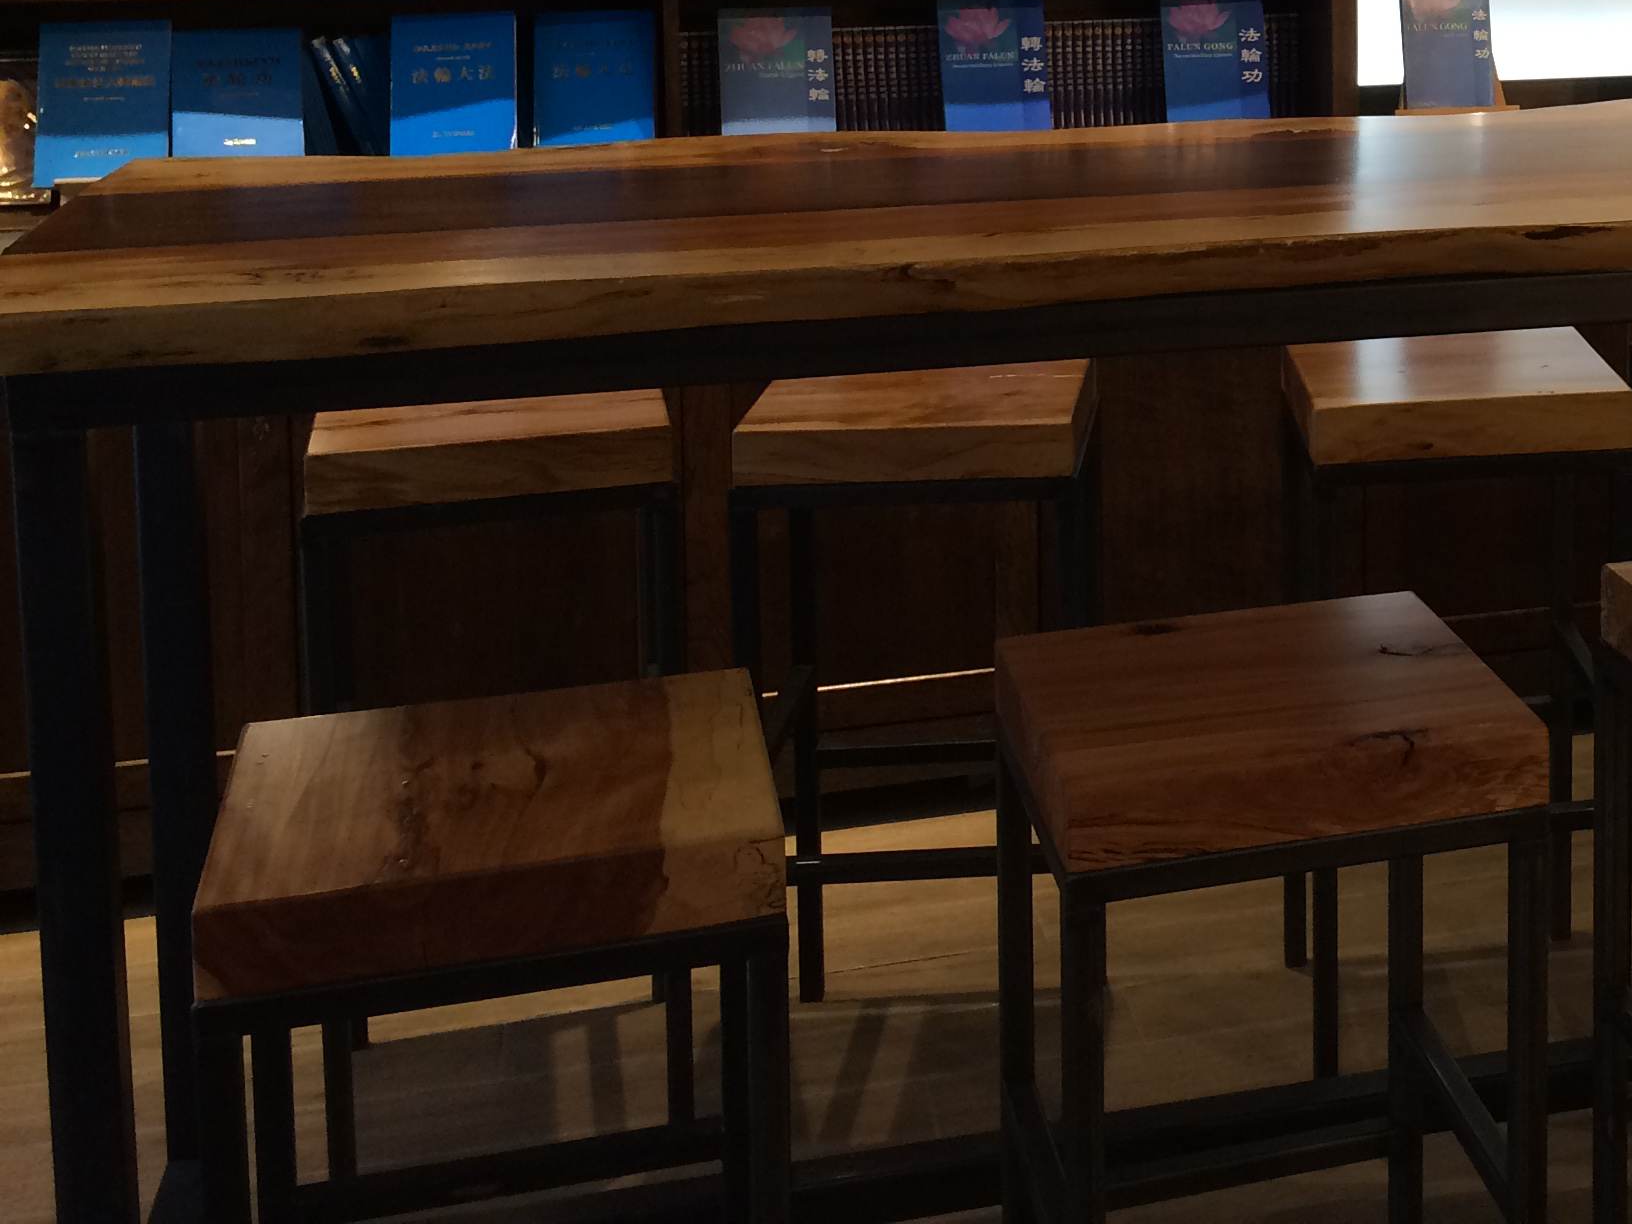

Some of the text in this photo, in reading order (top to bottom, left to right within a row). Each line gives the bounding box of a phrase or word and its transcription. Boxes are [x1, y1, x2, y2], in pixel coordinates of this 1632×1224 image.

[1021, 37, 1046, 94] 轉法輪
[1167, 42, 1234, 52] FALUN GONG
[1239, 28, 1264, 83] 法輪功
